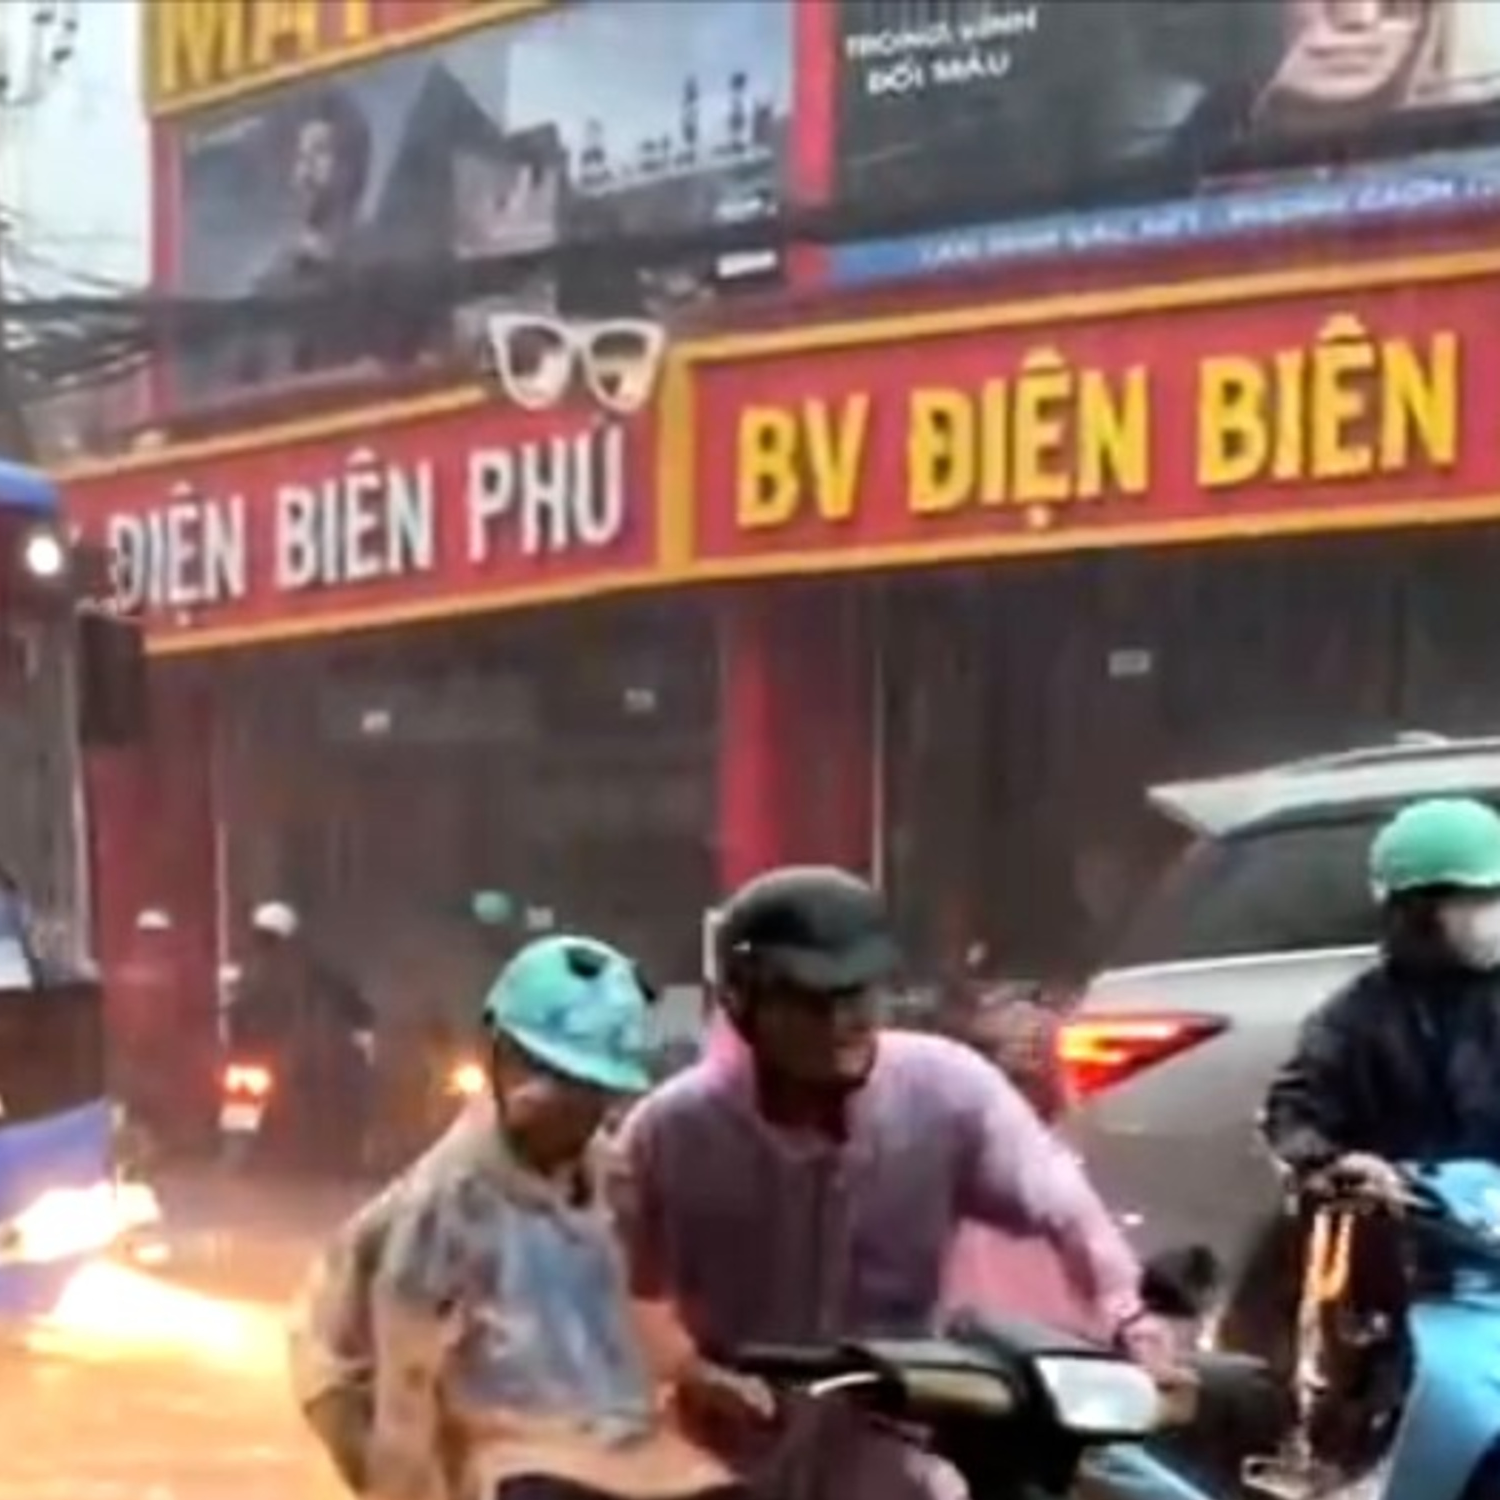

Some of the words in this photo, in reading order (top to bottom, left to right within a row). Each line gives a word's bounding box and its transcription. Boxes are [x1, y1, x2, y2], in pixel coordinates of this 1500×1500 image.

[736, 392, 870, 528] BV
[909, 346, 1149, 529] ĐIỆN
[1196, 312, 1457, 488] BIÊN
[107, 481, 245, 628] ĐIỆN
[274, 447, 434, 590] BIÊN
